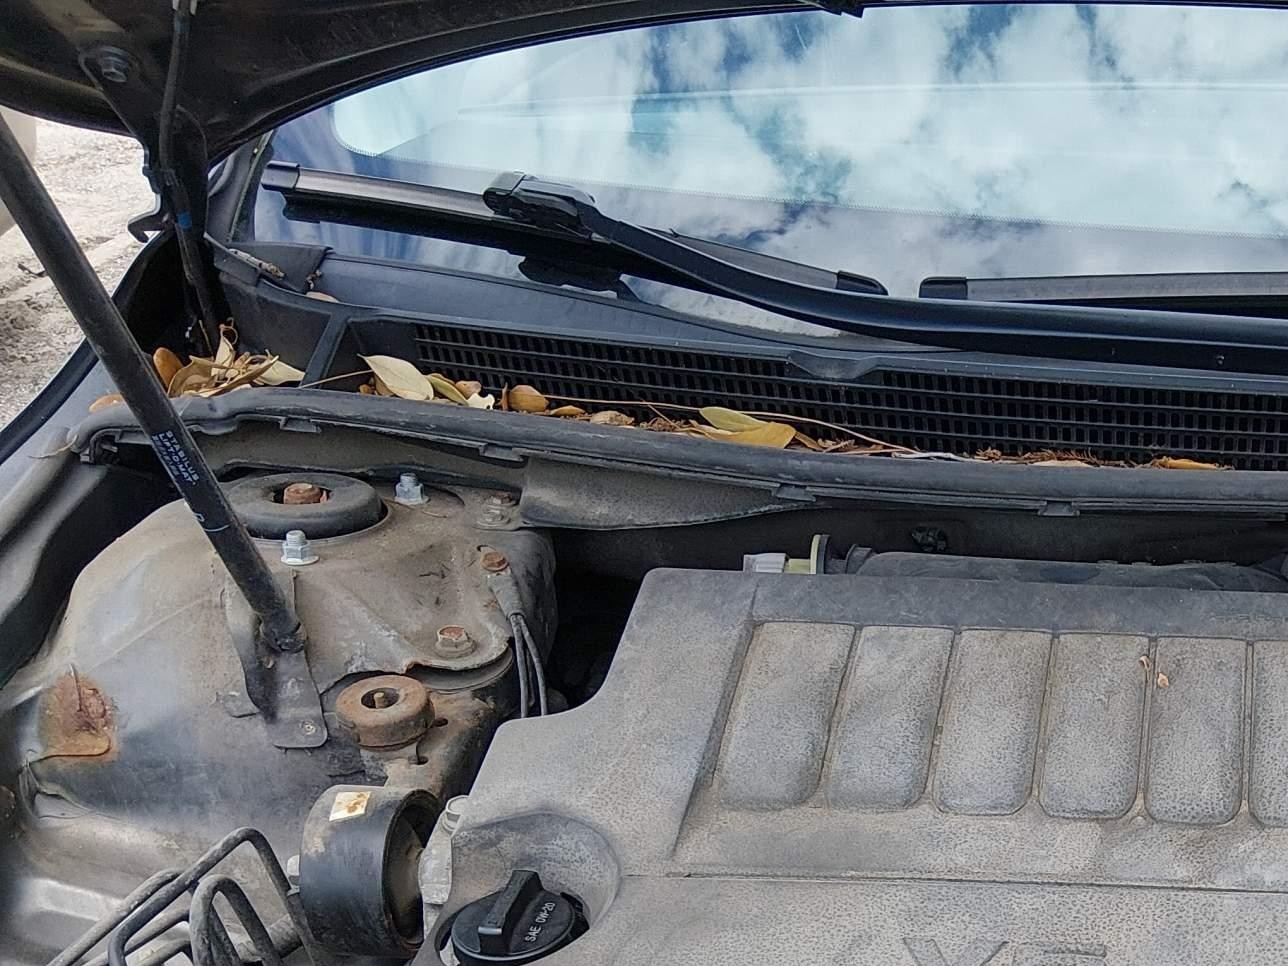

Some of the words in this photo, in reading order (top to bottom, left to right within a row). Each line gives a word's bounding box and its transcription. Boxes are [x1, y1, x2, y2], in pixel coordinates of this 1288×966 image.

[166, 430, 200, 481] STABILUS
[524, 926, 542, 942] SAE
[535, 902, 556, 923] 0W-20
